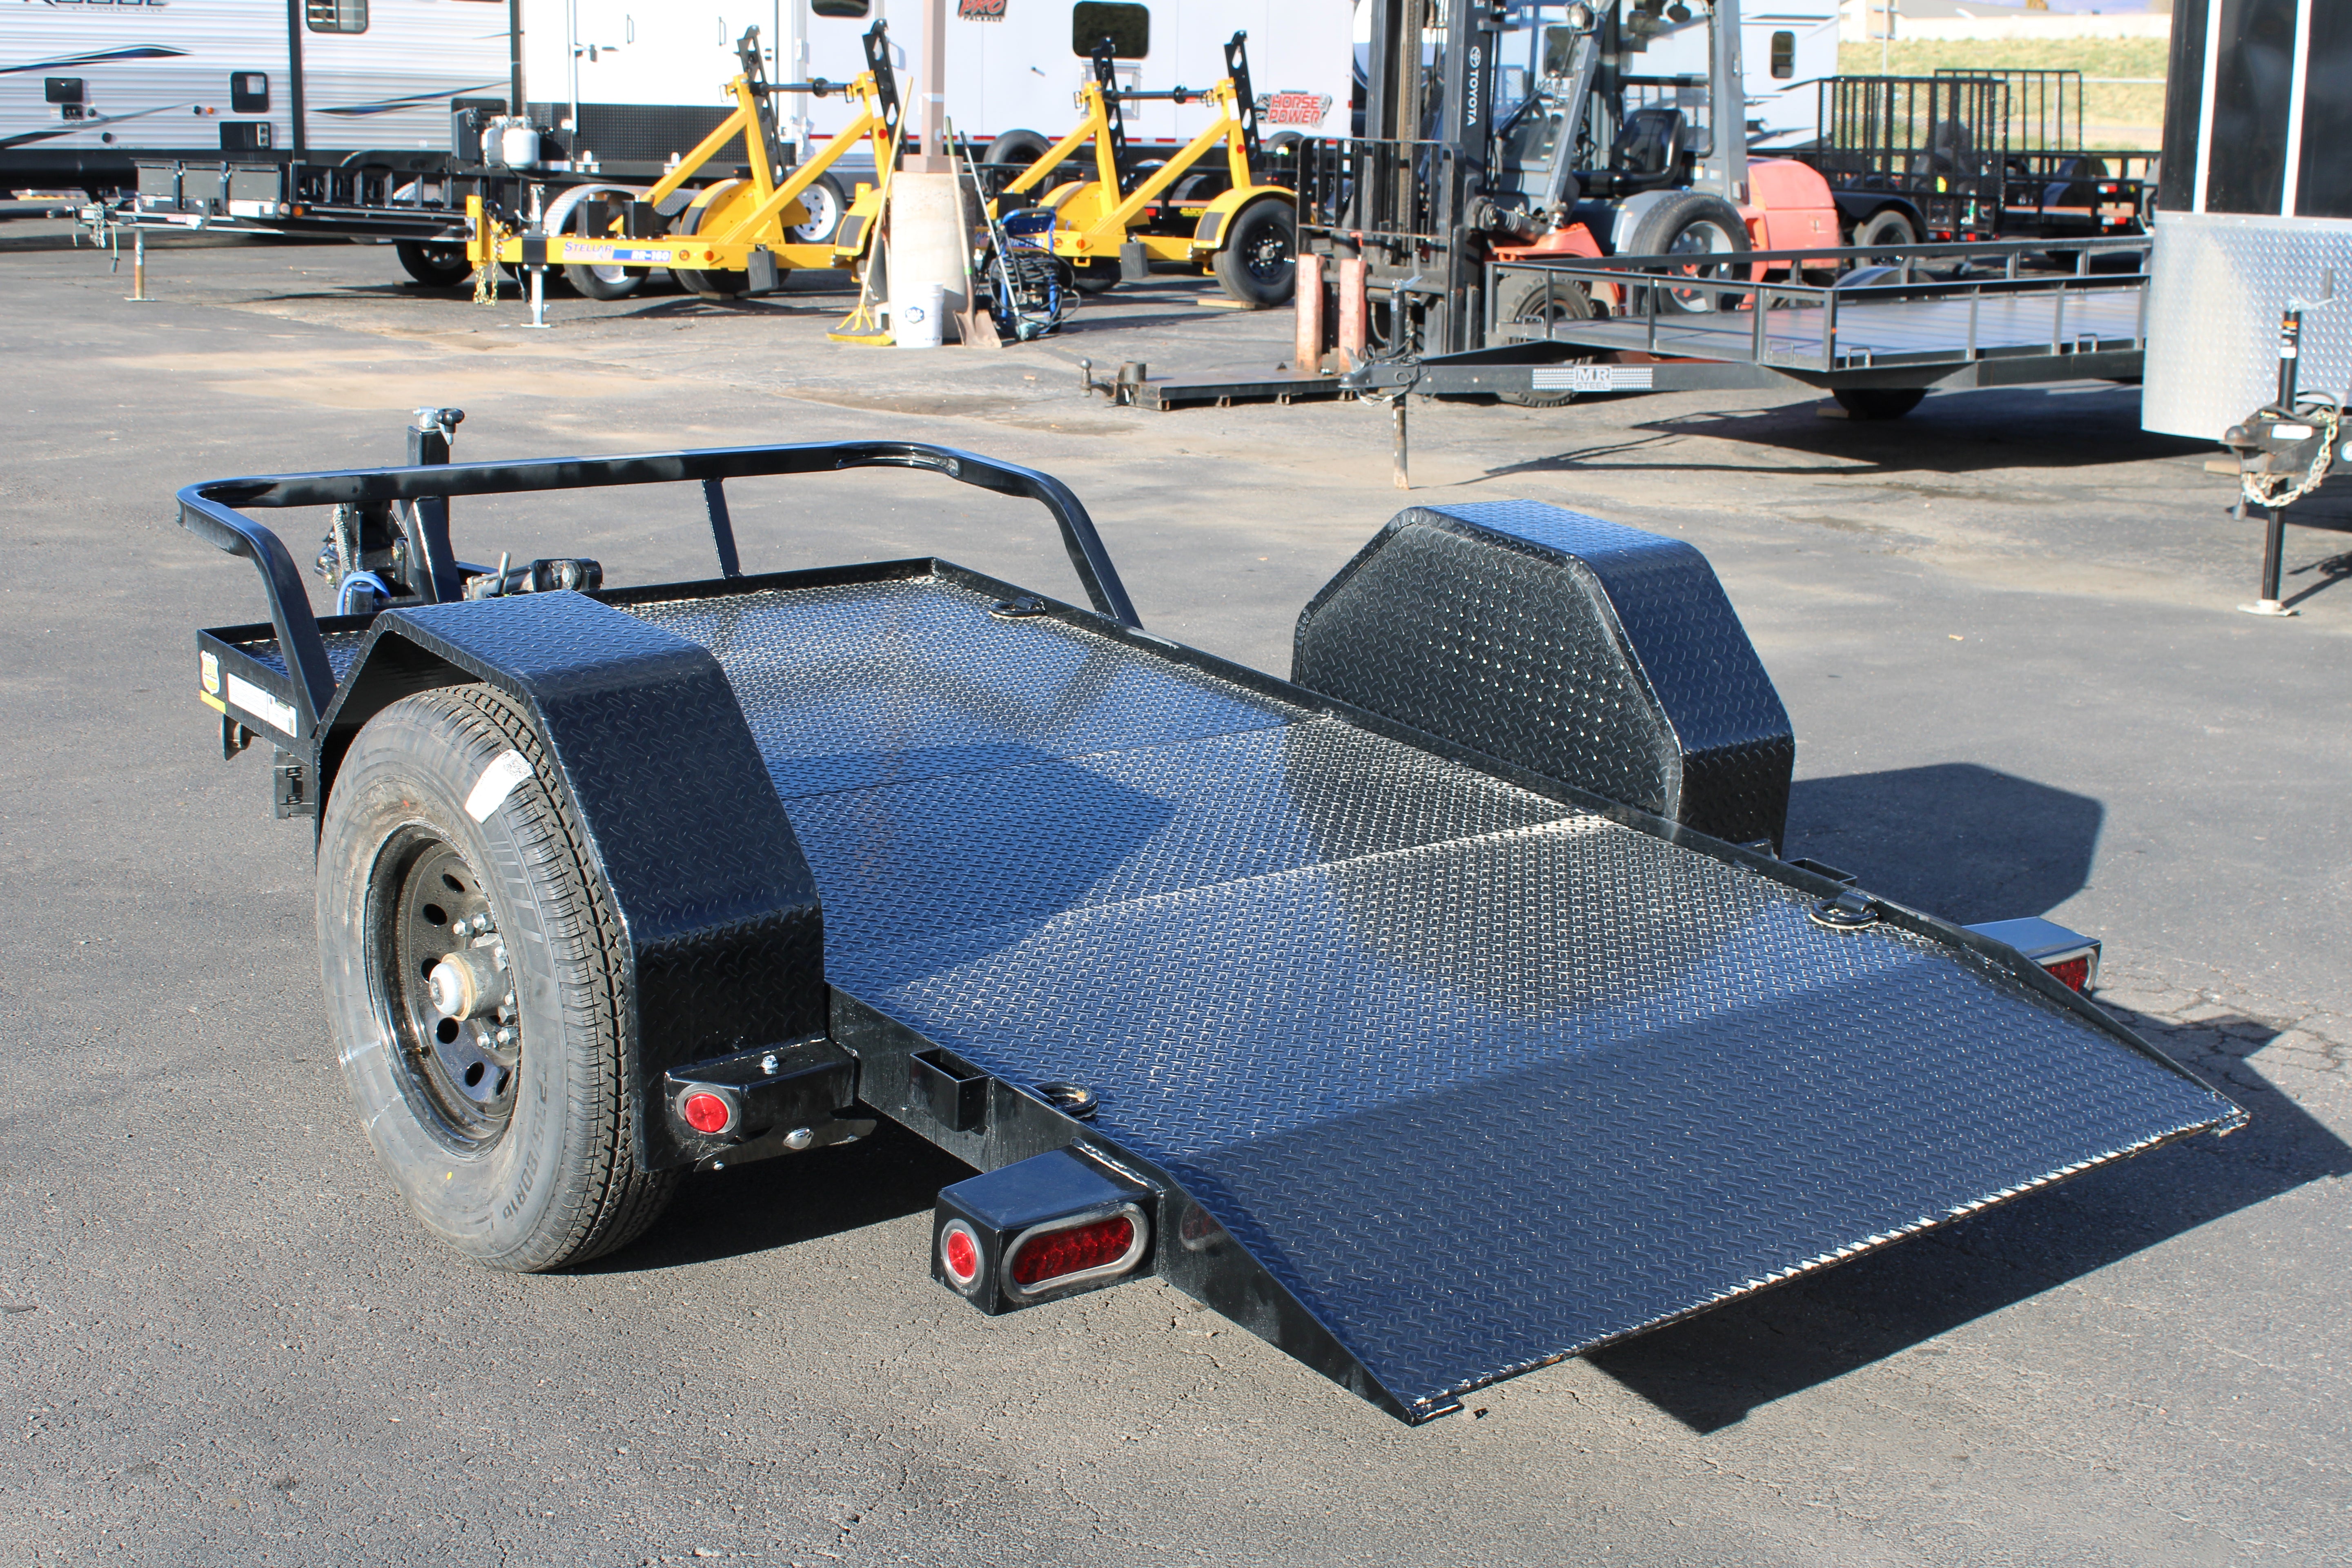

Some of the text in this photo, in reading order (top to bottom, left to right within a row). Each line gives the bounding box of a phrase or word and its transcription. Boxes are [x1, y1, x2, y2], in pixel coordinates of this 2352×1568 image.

[958, 0, 1005, 17] PRO
[1271, 95, 1321, 109] HORSE
[1467, 69, 1479, 126] TOYOTA
[1269, 109, 1321, 123] POWER
[565, 241, 612, 253] STELLAR
[631, 250, 670, 261] RR-160
[1576, 368, 1610, 381] MR
